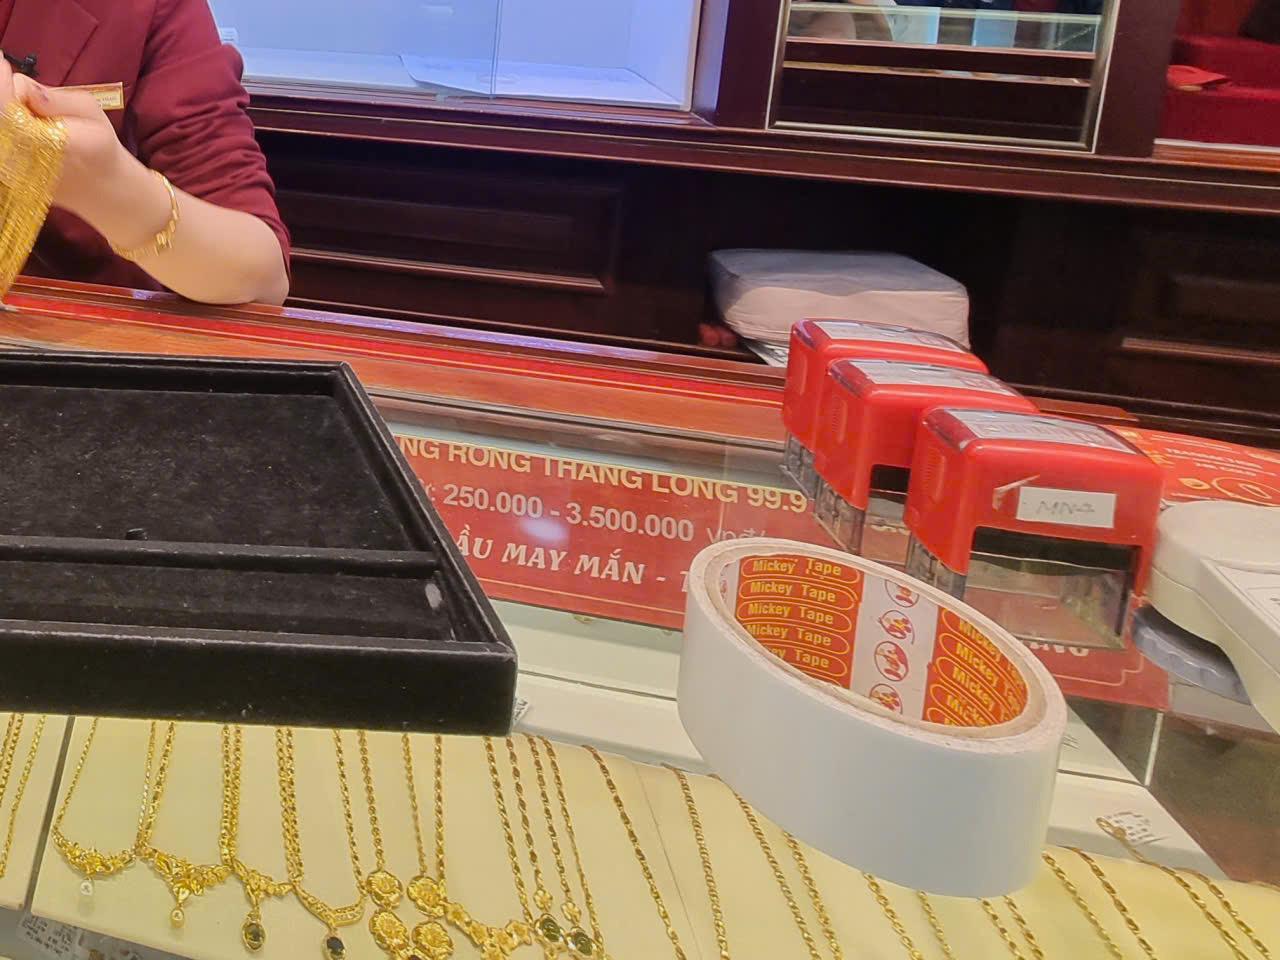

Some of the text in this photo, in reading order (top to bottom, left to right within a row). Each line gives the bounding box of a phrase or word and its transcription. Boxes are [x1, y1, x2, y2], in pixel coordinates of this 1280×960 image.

[443, 483, 694, 541] 250.000 3.500.000
[652, 474, 807, 512] LONG 99.9
[502, 542, 645, 584] MAY MẮN
[753, 558, 842, 575] Mickey Tape
[750, 582, 836, 602] Mickey Tape
[748, 602, 834, 624] Mickey Tape
[956, 643, 999, 686] Mickey
